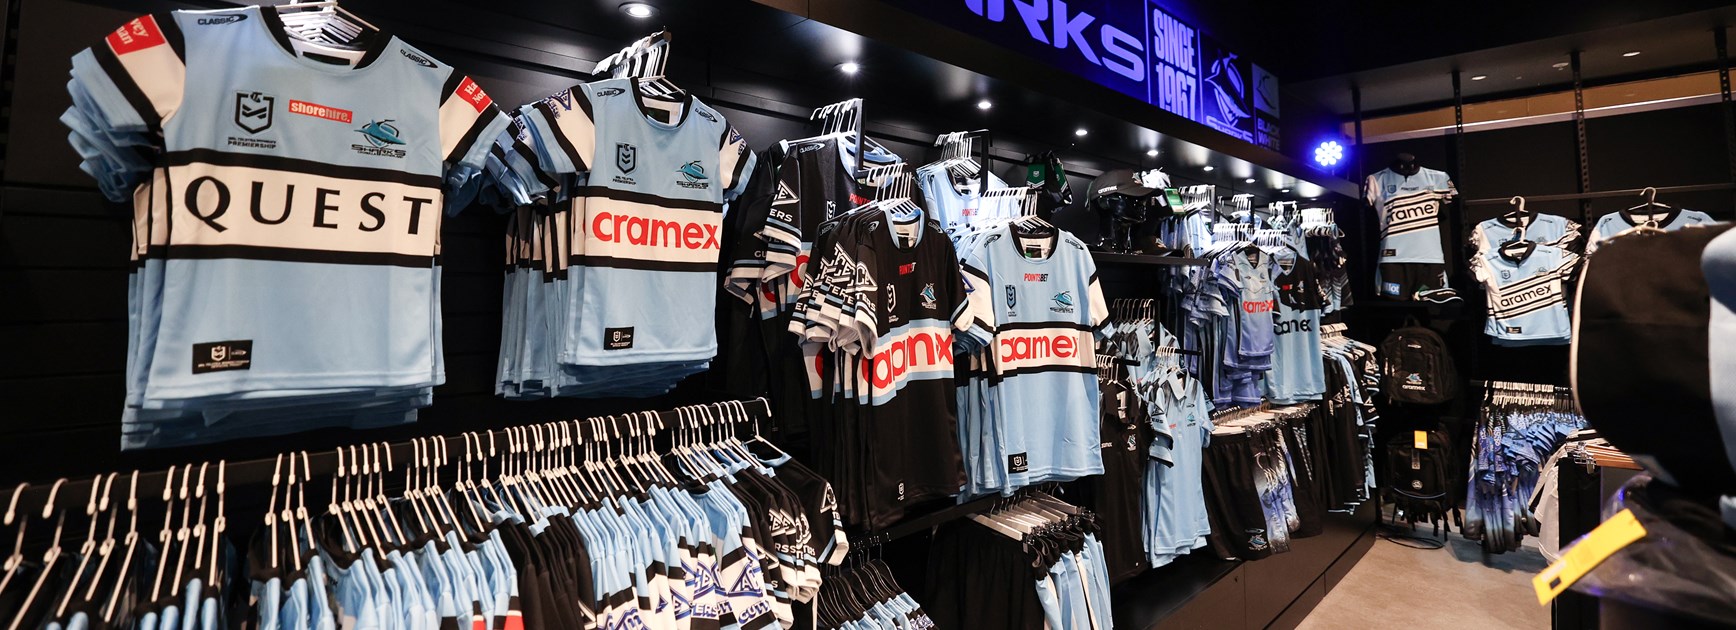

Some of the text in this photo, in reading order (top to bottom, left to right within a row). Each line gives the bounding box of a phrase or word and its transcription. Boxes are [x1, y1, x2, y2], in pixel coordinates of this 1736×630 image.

[197, 15, 234, 26] CLASSIC
[1153, 8, 1197, 76] SINCE
[399, 48, 427, 65] CLASSIC
[1155, 61, 1197, 122] 1967
[291, 101, 351, 123] shorehire.
[228, 141, 276, 149] PREMIERSHIP
[351, 144, 406, 157] SHARKS
[184, 175, 433, 236] QUEST
[1023, 273, 1048, 282] POINTSBET
[1500, 284, 1552, 307] aramex
